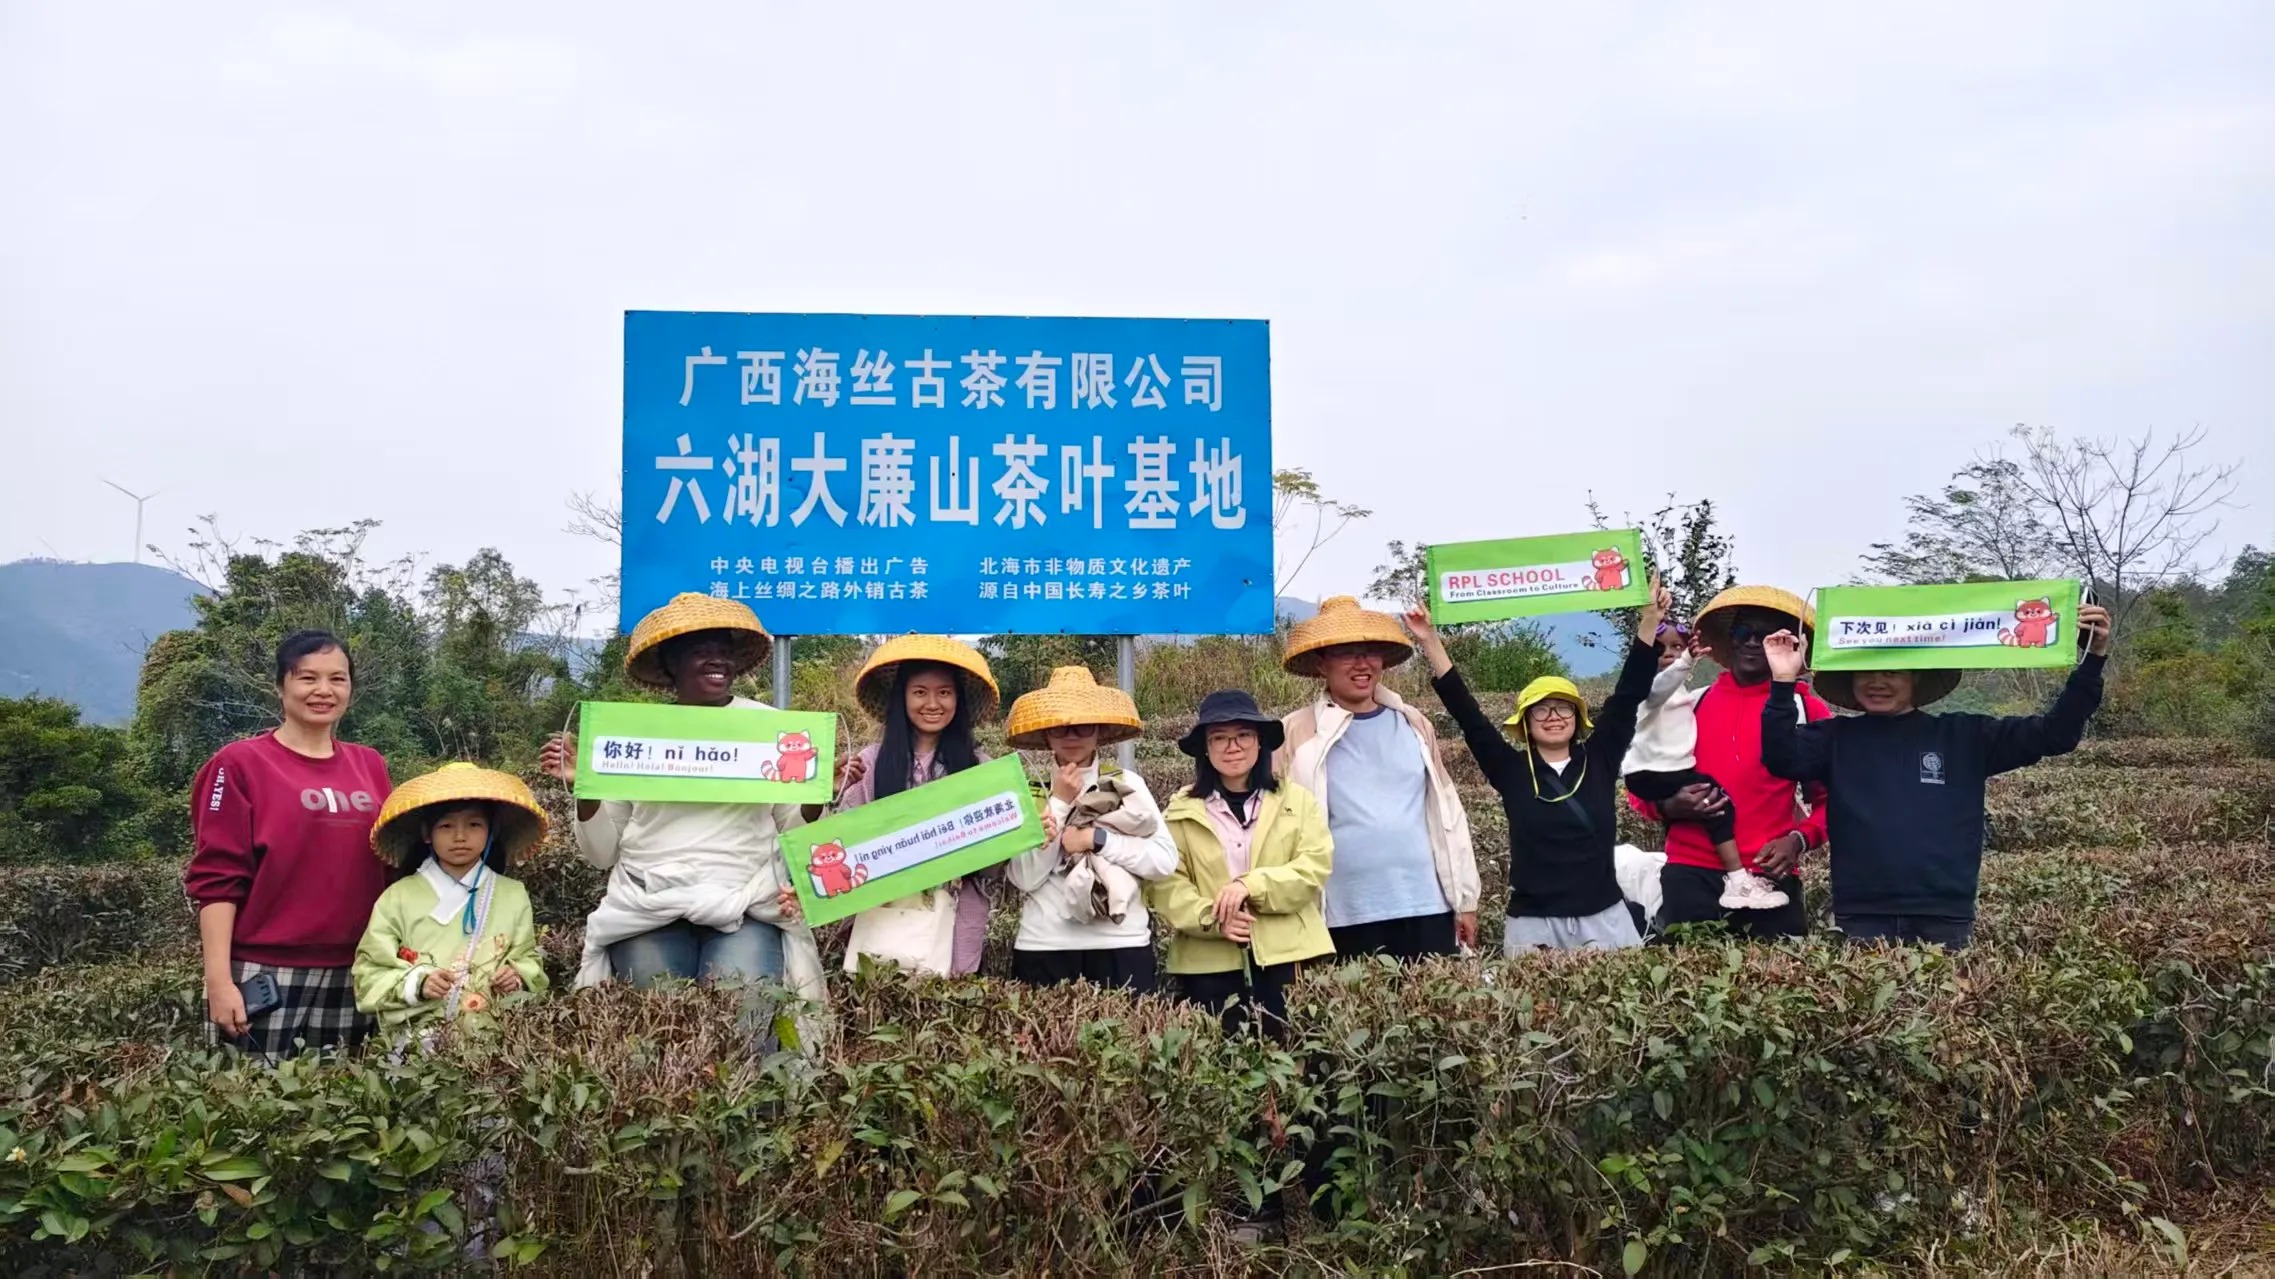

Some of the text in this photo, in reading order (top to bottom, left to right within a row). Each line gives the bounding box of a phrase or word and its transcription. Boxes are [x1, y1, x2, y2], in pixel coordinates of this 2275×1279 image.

[679, 346, 1223, 412] 广西海丝古茶有限公司
[655, 431, 1246, 530] 六湖大廉山茶叶基地
[710, 556, 929, 575] 中央电视台播出广告
[979, 557, 1192, 576] 北海市非物质文化遗产
[1449, 568, 1566, 590] RPL SCHOOL
[710, 581, 929, 600] 海上丝绸之路外销古茶
[979, 581, 1192, 600] 源自中国长寿之乡茶叶
[1450, 582, 1579, 599] From Classroom to Culture
[1886, 635, 1912, 643] next
[300, 787, 374, 813] one
